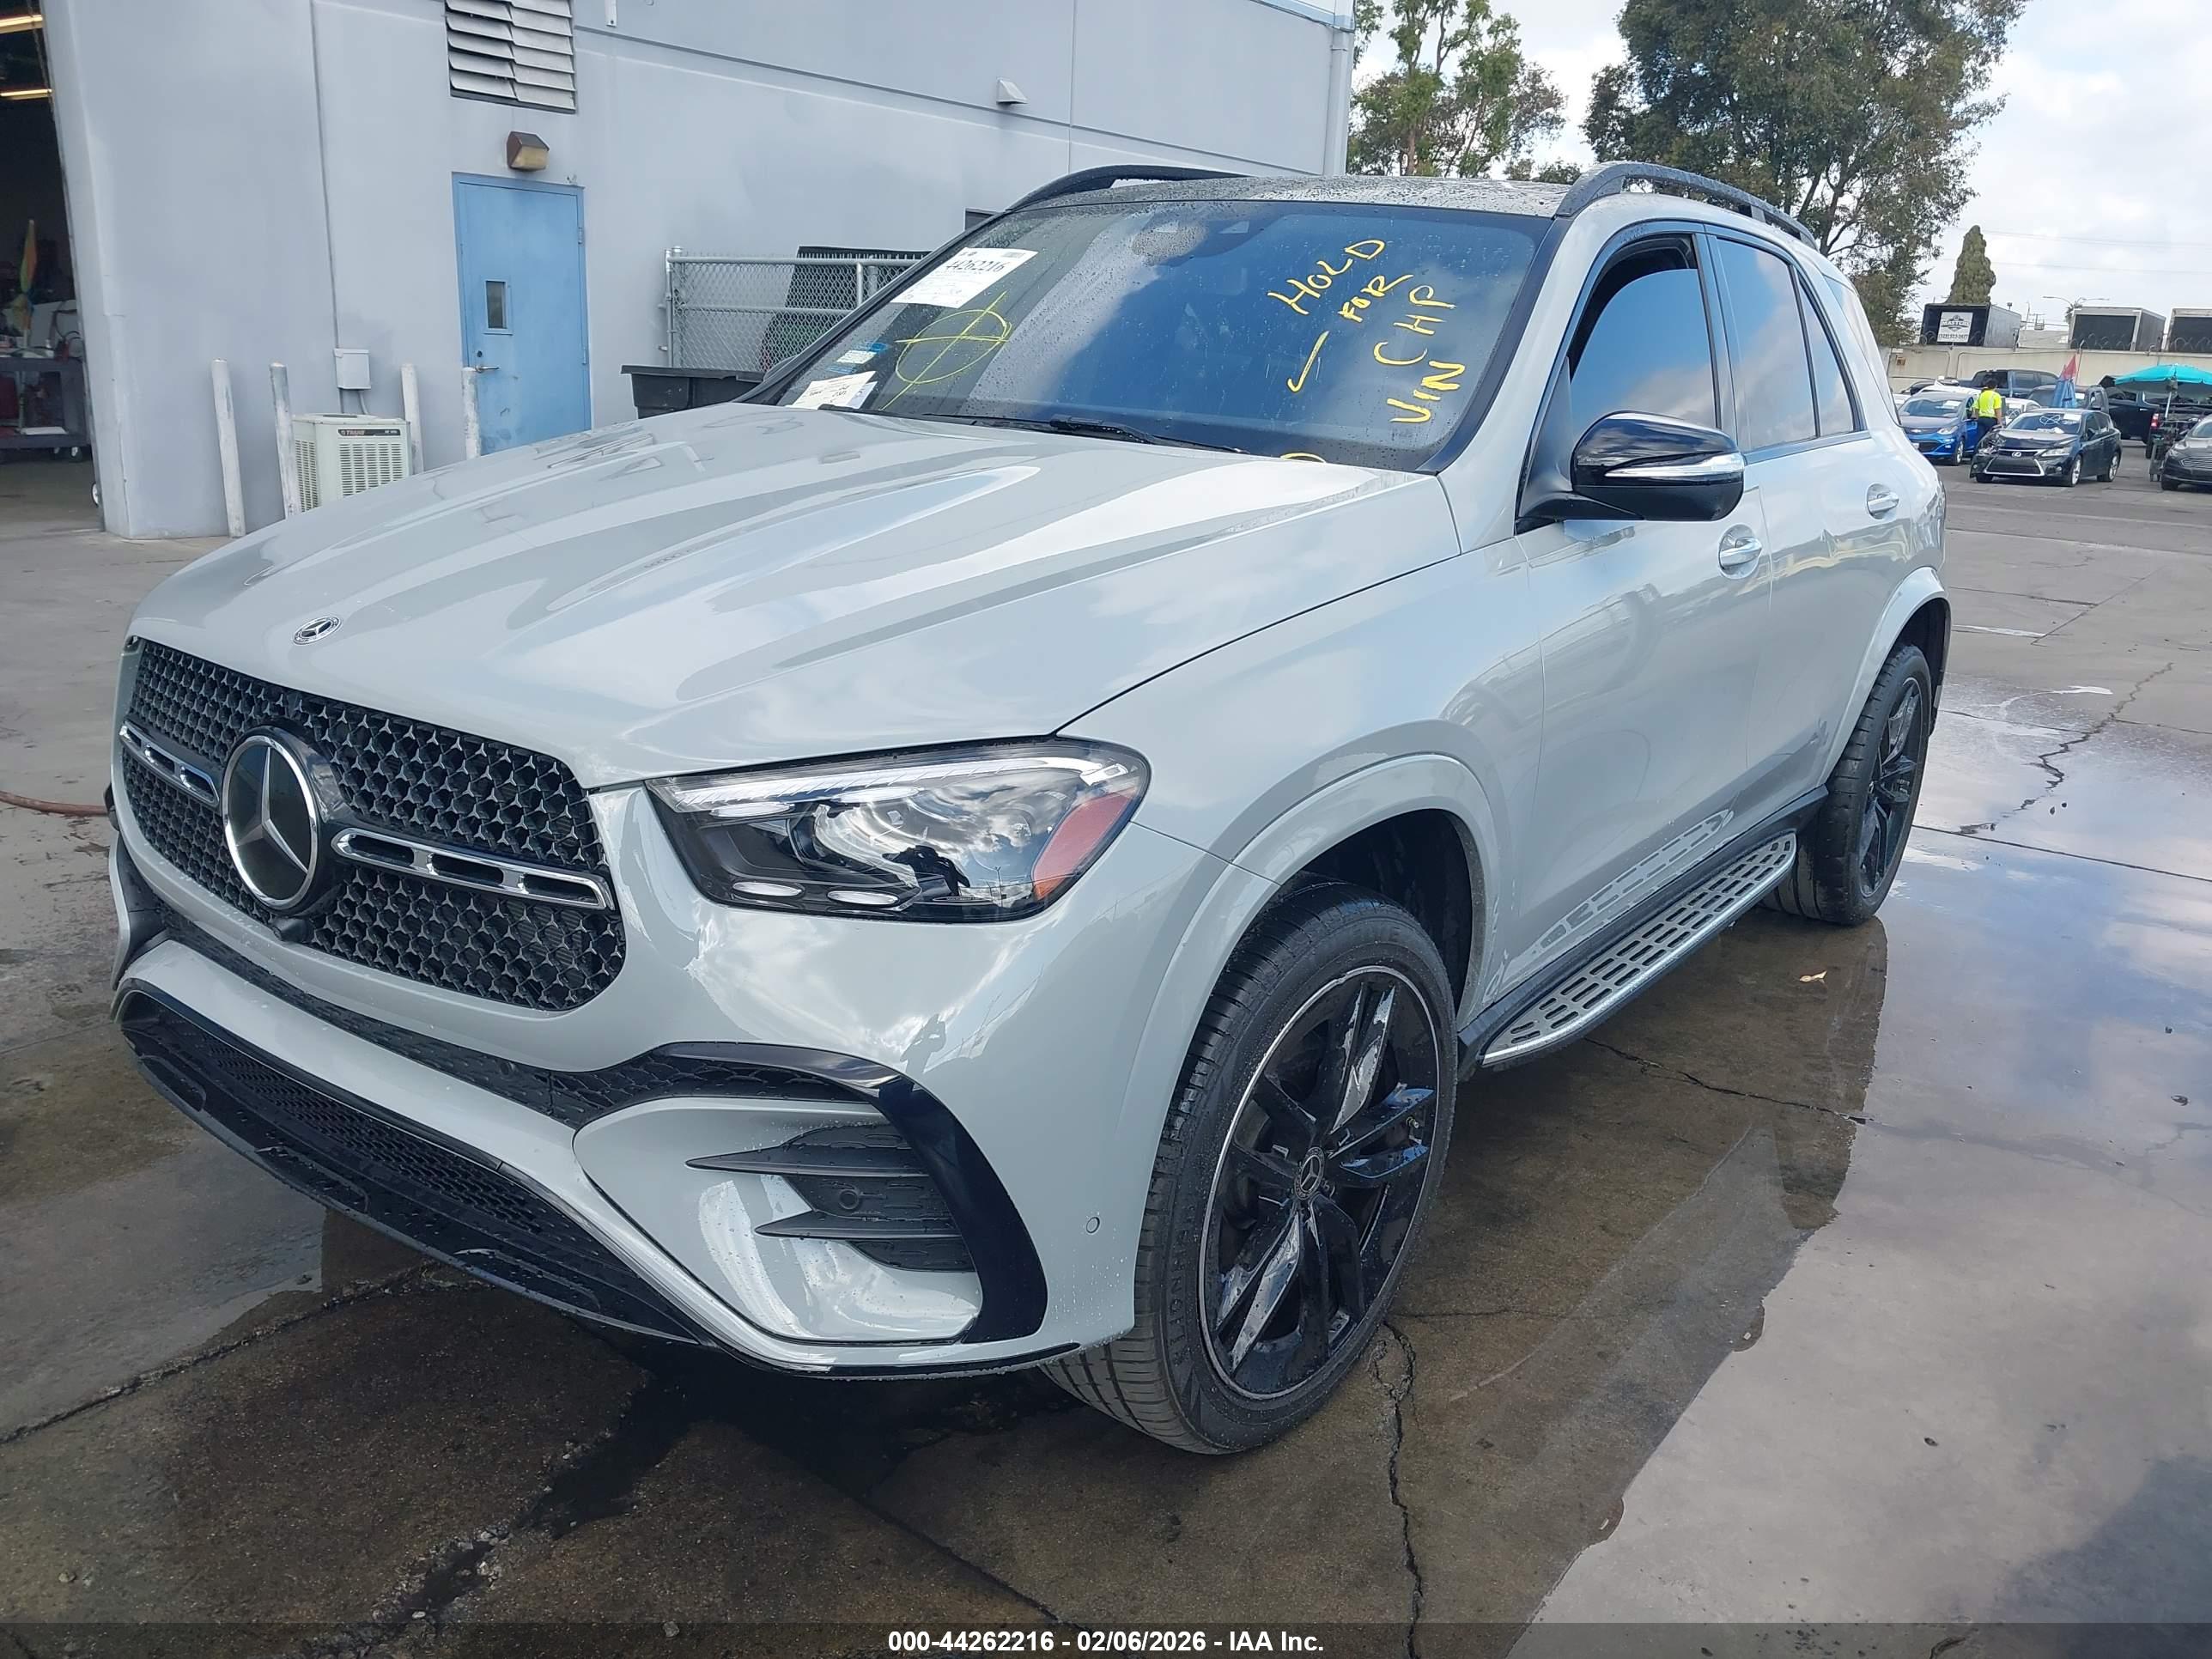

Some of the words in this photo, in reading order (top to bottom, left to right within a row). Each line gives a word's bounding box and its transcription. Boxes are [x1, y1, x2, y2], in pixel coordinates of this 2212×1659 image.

[1267, 239, 1387, 315] HOLD
[1337, 274, 1414, 323] FOR
[1373, 284, 1457, 366] CHP
[1386, 360, 1467, 423] VIN
